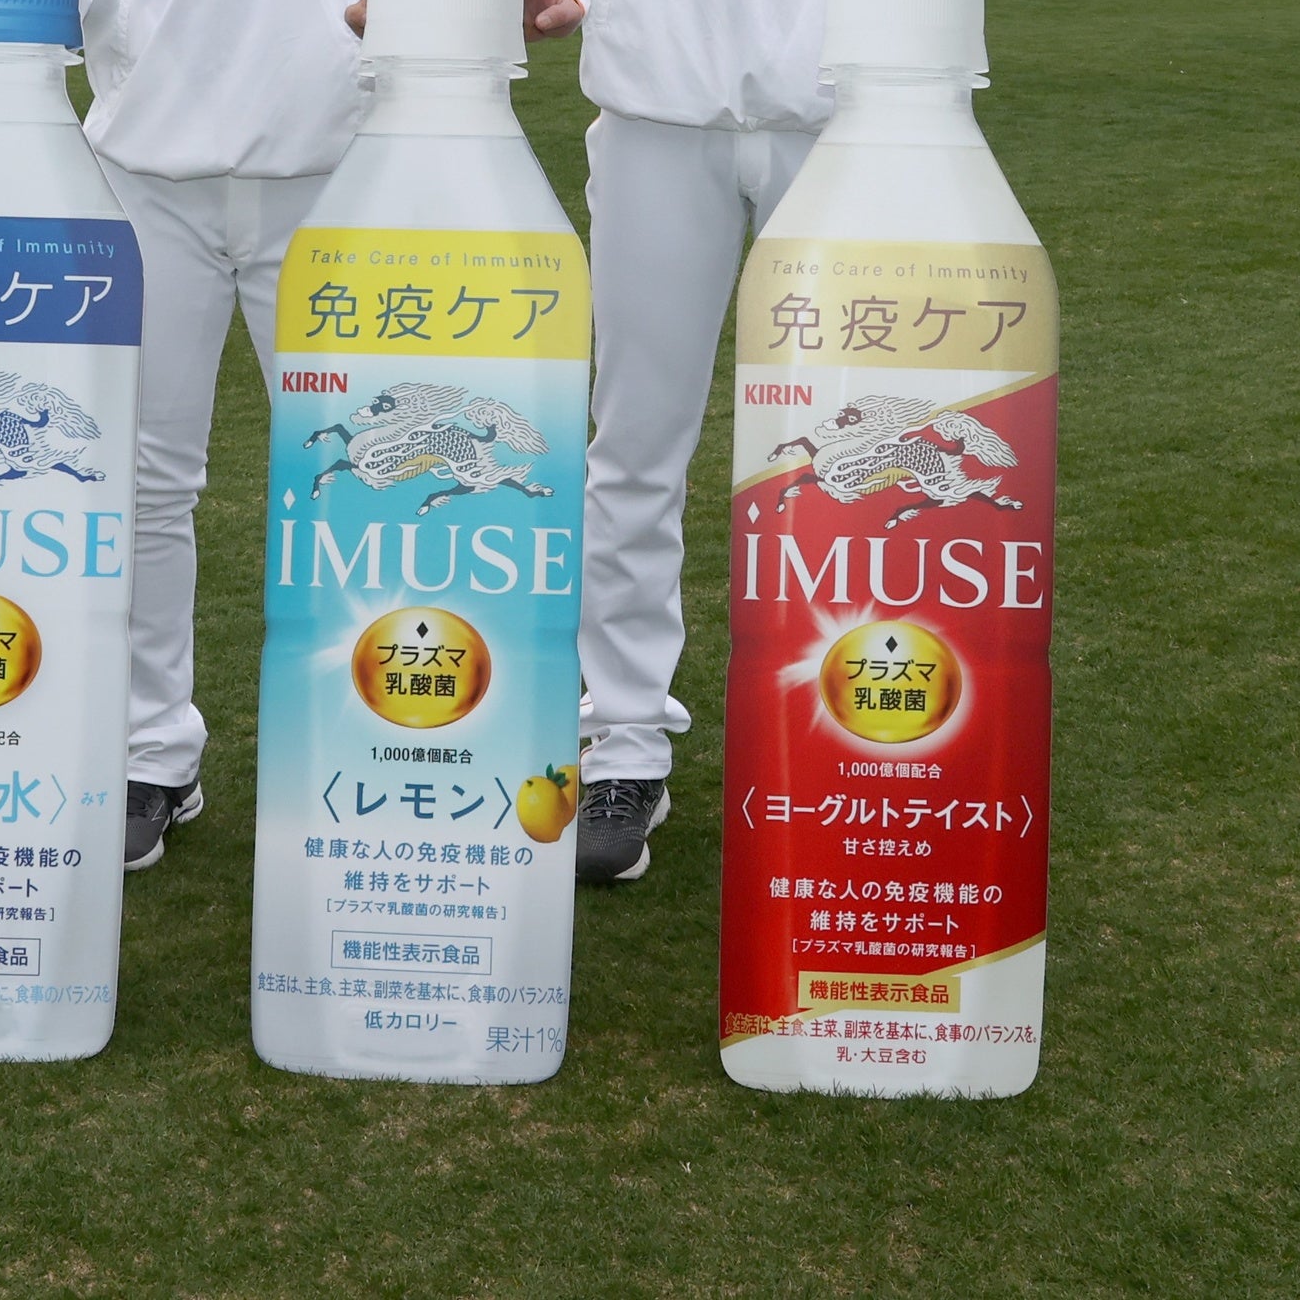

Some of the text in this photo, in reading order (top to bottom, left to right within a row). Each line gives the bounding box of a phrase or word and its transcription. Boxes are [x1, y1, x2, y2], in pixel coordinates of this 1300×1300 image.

[16, 238, 115, 259] Immunity
[310, 249, 562, 272] Take Care of Immunity
[771, 260, 1029, 284] Take Care of Immunity
[305, 281, 560, 341] 免疫ケア
[769, 292, 1027, 353] 免疫ケア
[281, 371, 348, 394] KIRIN
[745, 384, 813, 406] KIRIN
[377, 644, 466, 668] プラズマ
[846, 658, 937, 683] プラズマ
[385, 672, 456, 697] 乳酸菌
[854, 687, 926, 712] 乳酸菌
[371, 747, 473, 764] 1,000億個配合
[838, 762, 943, 780] 1,000億個配合
[304, 837, 534, 867] 健康な人の免疫機能の
[843, 837, 932, 857] 甘さ控えめ
[344, 870, 491, 896] 維持をサポート
[769, 876, 1003, 905] 健康な人の免疫機能の
[810, 910, 960, 935] 維持をサポート
[342, 940, 480, 965] 機能性表示食品
[809, 980, 949, 1004] 機能性表示食品
[364, 1010, 457, 1032] 低カロリー
[486, 1026, 563, 1053] 果汁1%
[837, 1046, 927, 1065] 乳・大豆含む
